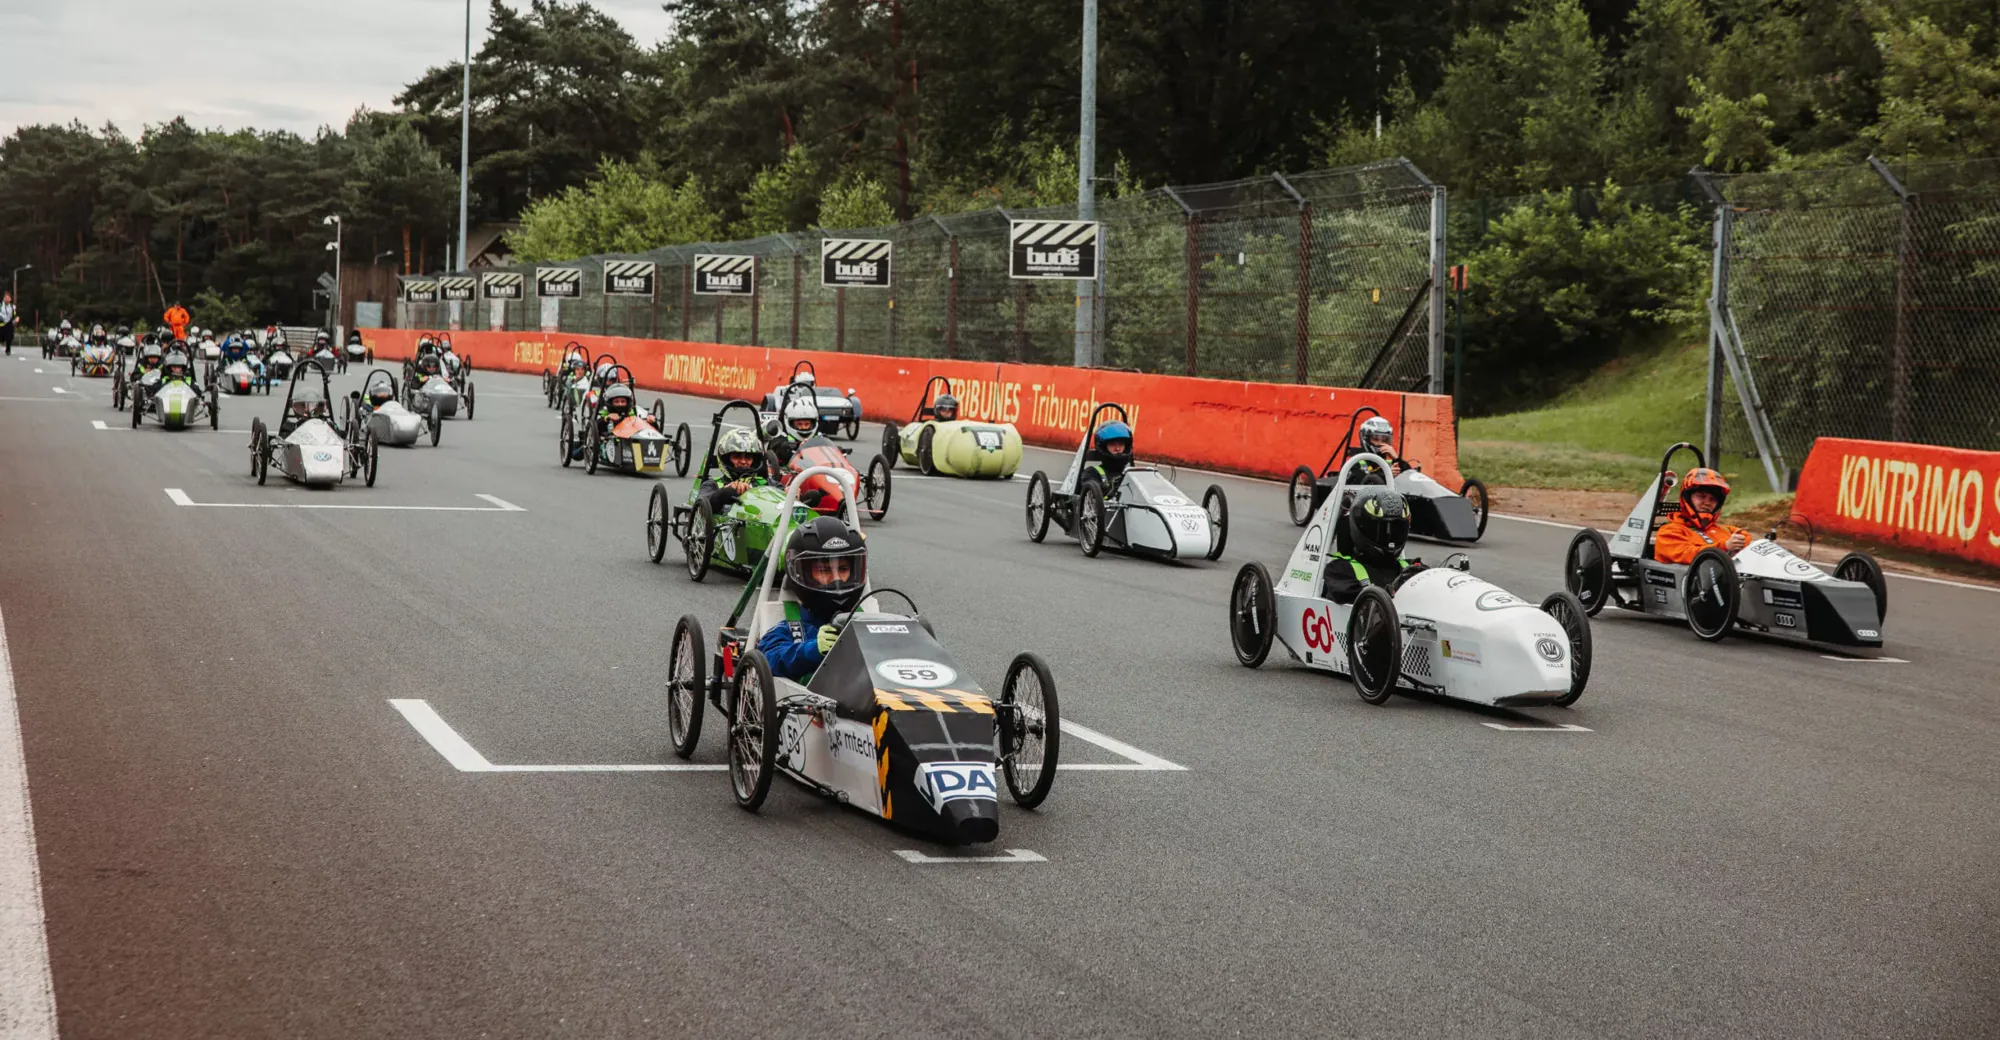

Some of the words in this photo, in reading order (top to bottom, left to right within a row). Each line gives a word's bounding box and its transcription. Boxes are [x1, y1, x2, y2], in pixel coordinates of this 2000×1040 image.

[1836, 454, 1984, 541] KONTRIMO
[1303, 543, 1321, 553] MAN
[897, 669, 939, 681] 59
[919, 769, 997, 808] VDA
